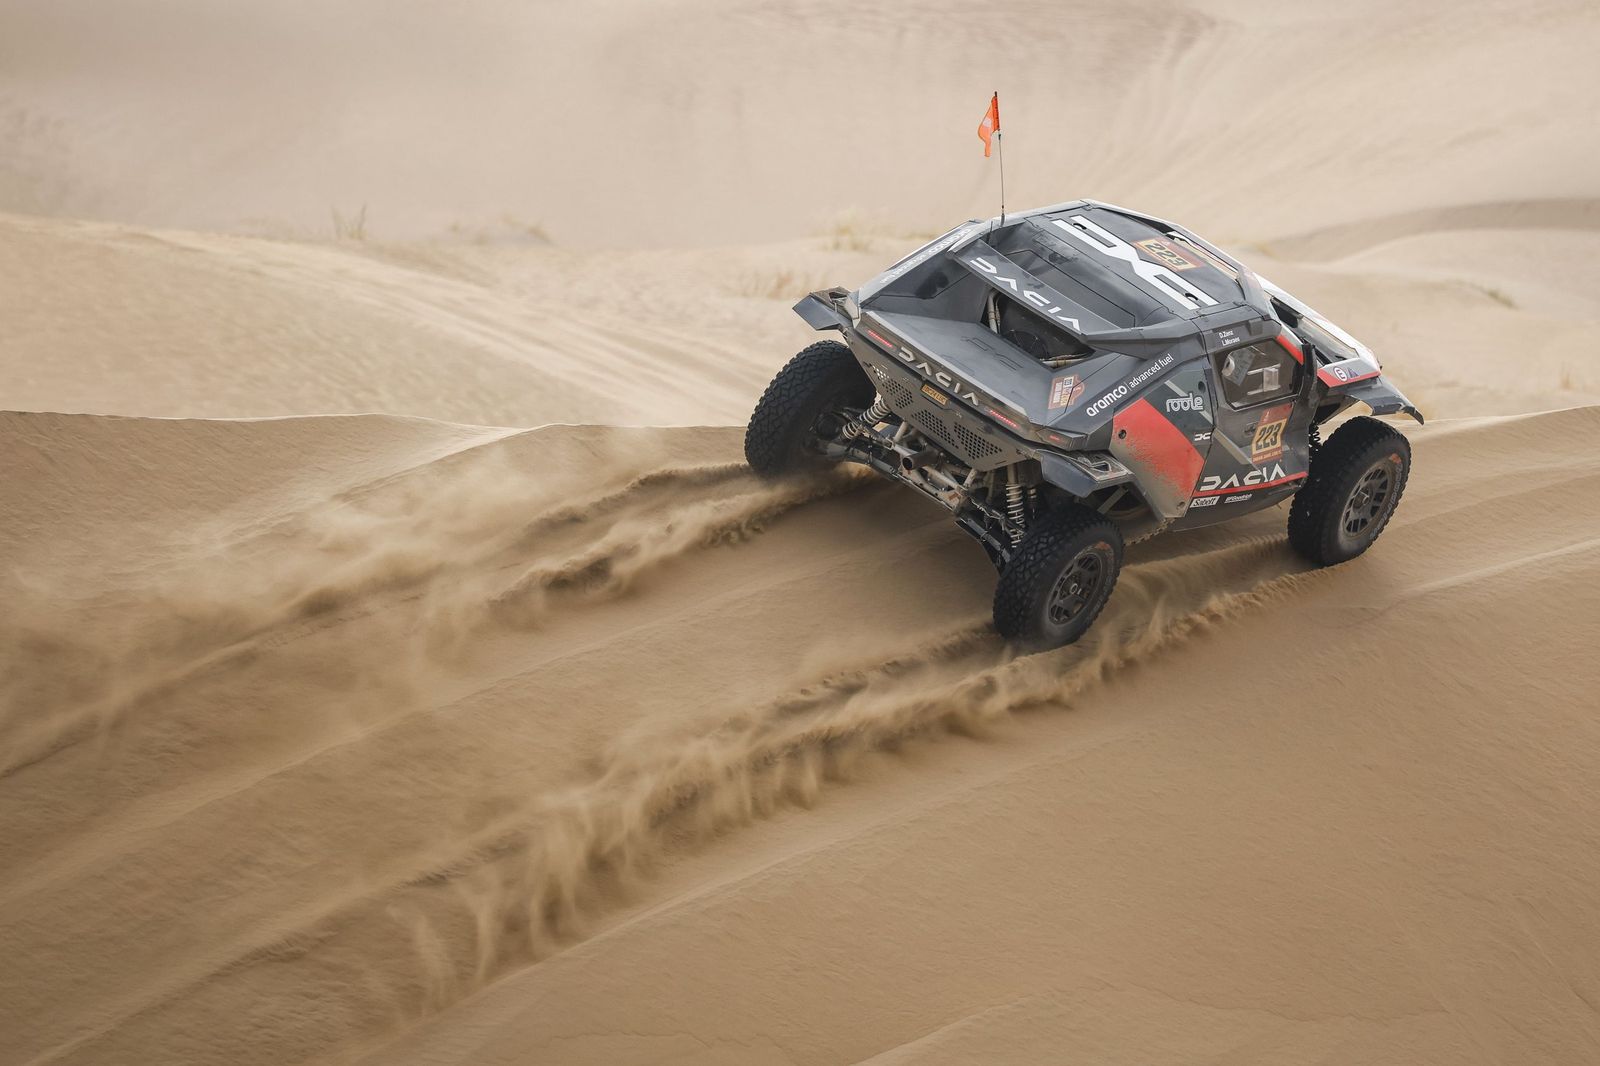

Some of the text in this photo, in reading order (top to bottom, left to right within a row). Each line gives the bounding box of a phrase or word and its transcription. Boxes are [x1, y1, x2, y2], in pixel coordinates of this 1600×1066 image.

[1145, 242, 1188, 267] 223
[970, 257, 1082, 331] DACIA
[898, 346, 980, 406] DACIA
[1086, 385, 1128, 417] aramco
[1128, 361, 1161, 388] advanced
[1159, 353, 1174, 368] fuel
[1255, 422, 1282, 450] 223
[1200, 463, 1286, 491] DACIA
